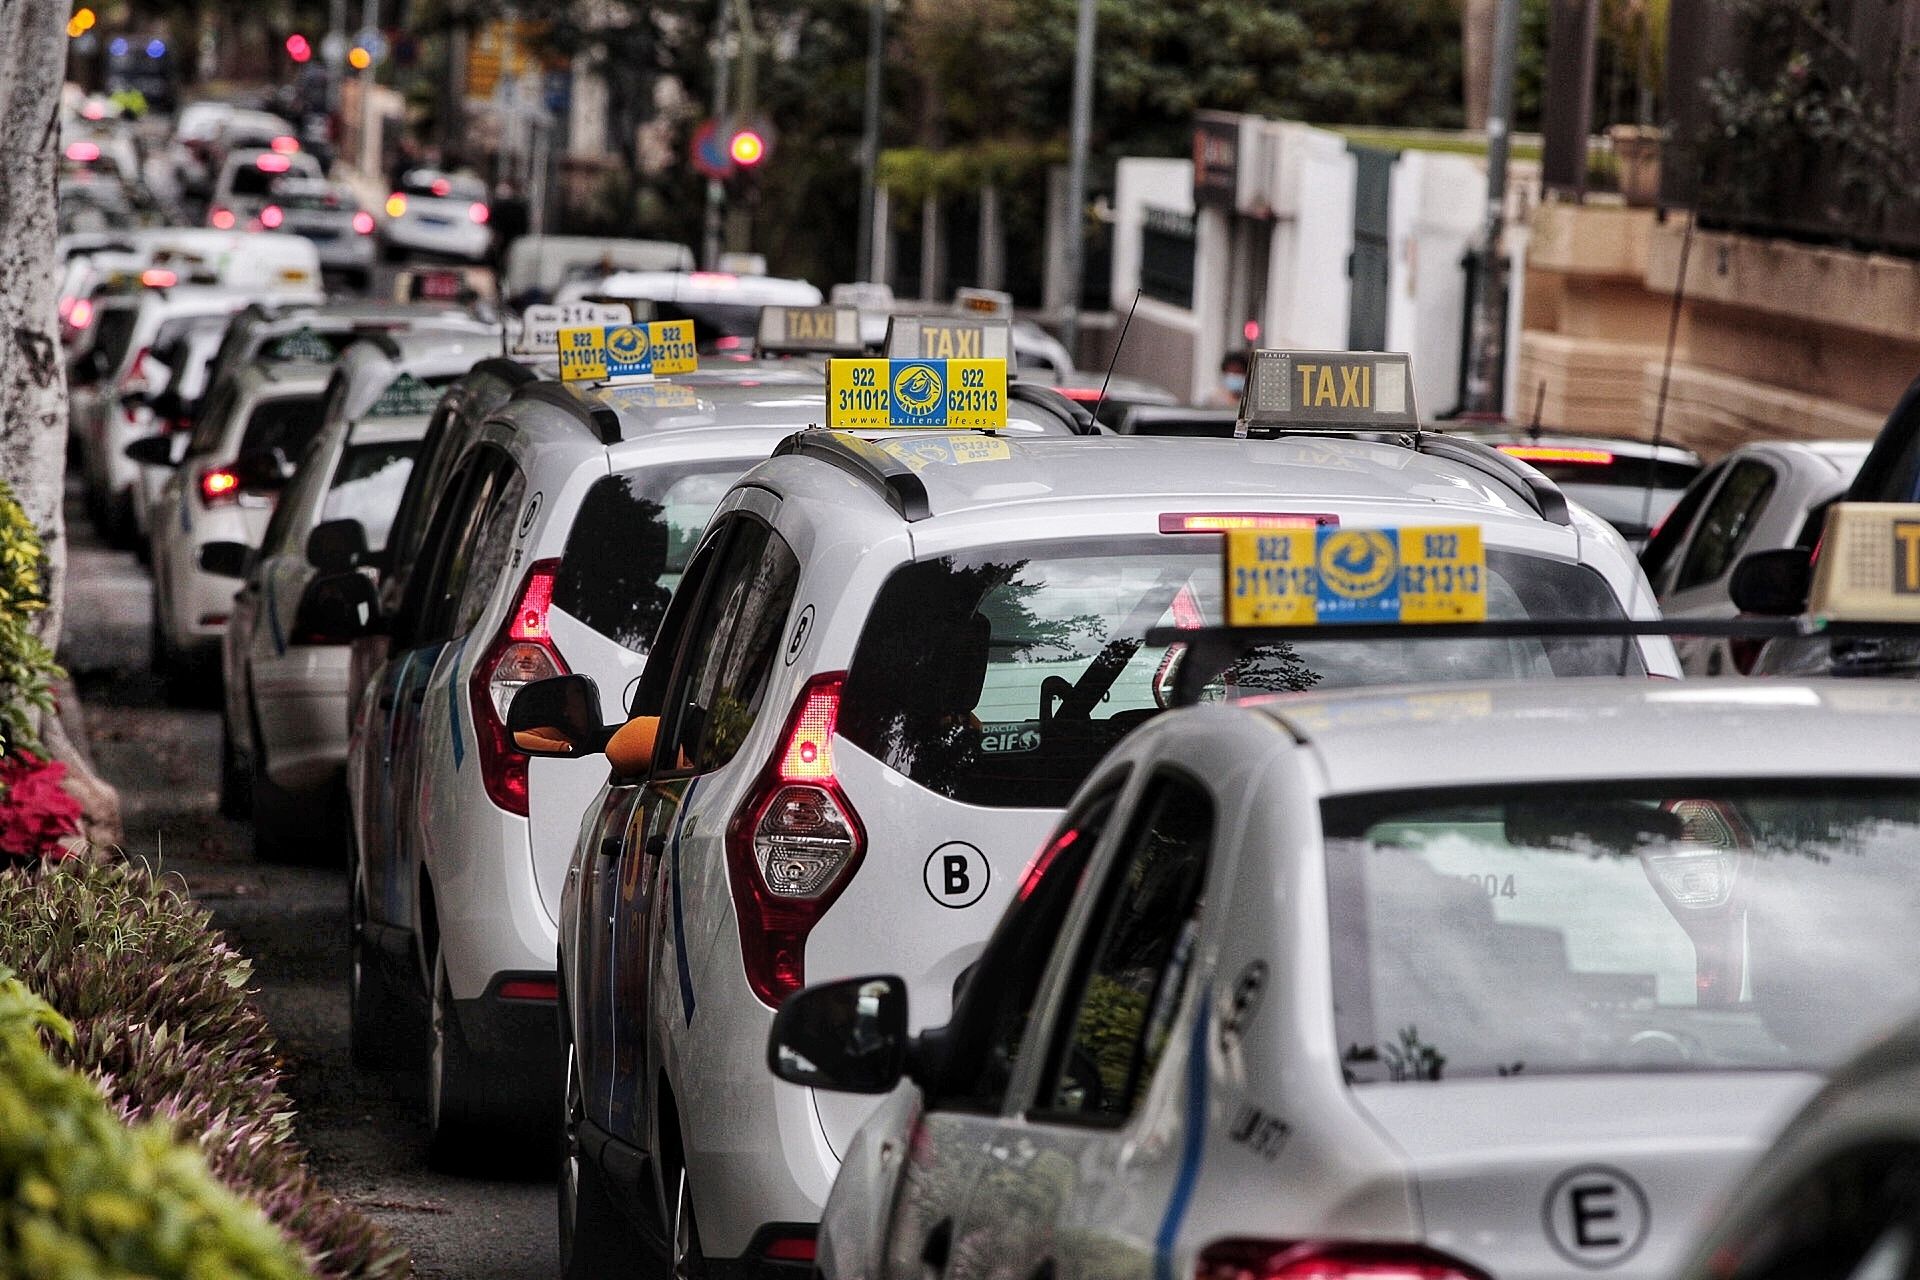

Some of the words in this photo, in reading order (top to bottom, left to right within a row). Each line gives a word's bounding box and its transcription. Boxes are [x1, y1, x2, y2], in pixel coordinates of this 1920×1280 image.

[787, 311, 834, 339] TAXI
[573, 333, 592, 347] 922
[662, 327, 681, 342] 922
[922, 327, 980, 358] TAXI
[563, 349, 606, 366] 311012
[652, 343, 694, 361] 621313
[852, 368, 875, 386] 922
[962, 369, 984, 387] 922
[1297, 365, 1370, 407] TAXI
[839, 389, 889, 410] 311012
[950, 390, 998, 411] 621313
[850, 416, 987, 425] www.taxitenerife.es
[790, 616, 808, 653] B
[982, 724, 1020, 734] DACIA
[981, 733, 1020, 751] elf
[943, 855, 970, 895] B
[1570, 1185, 1622, 1247] E
